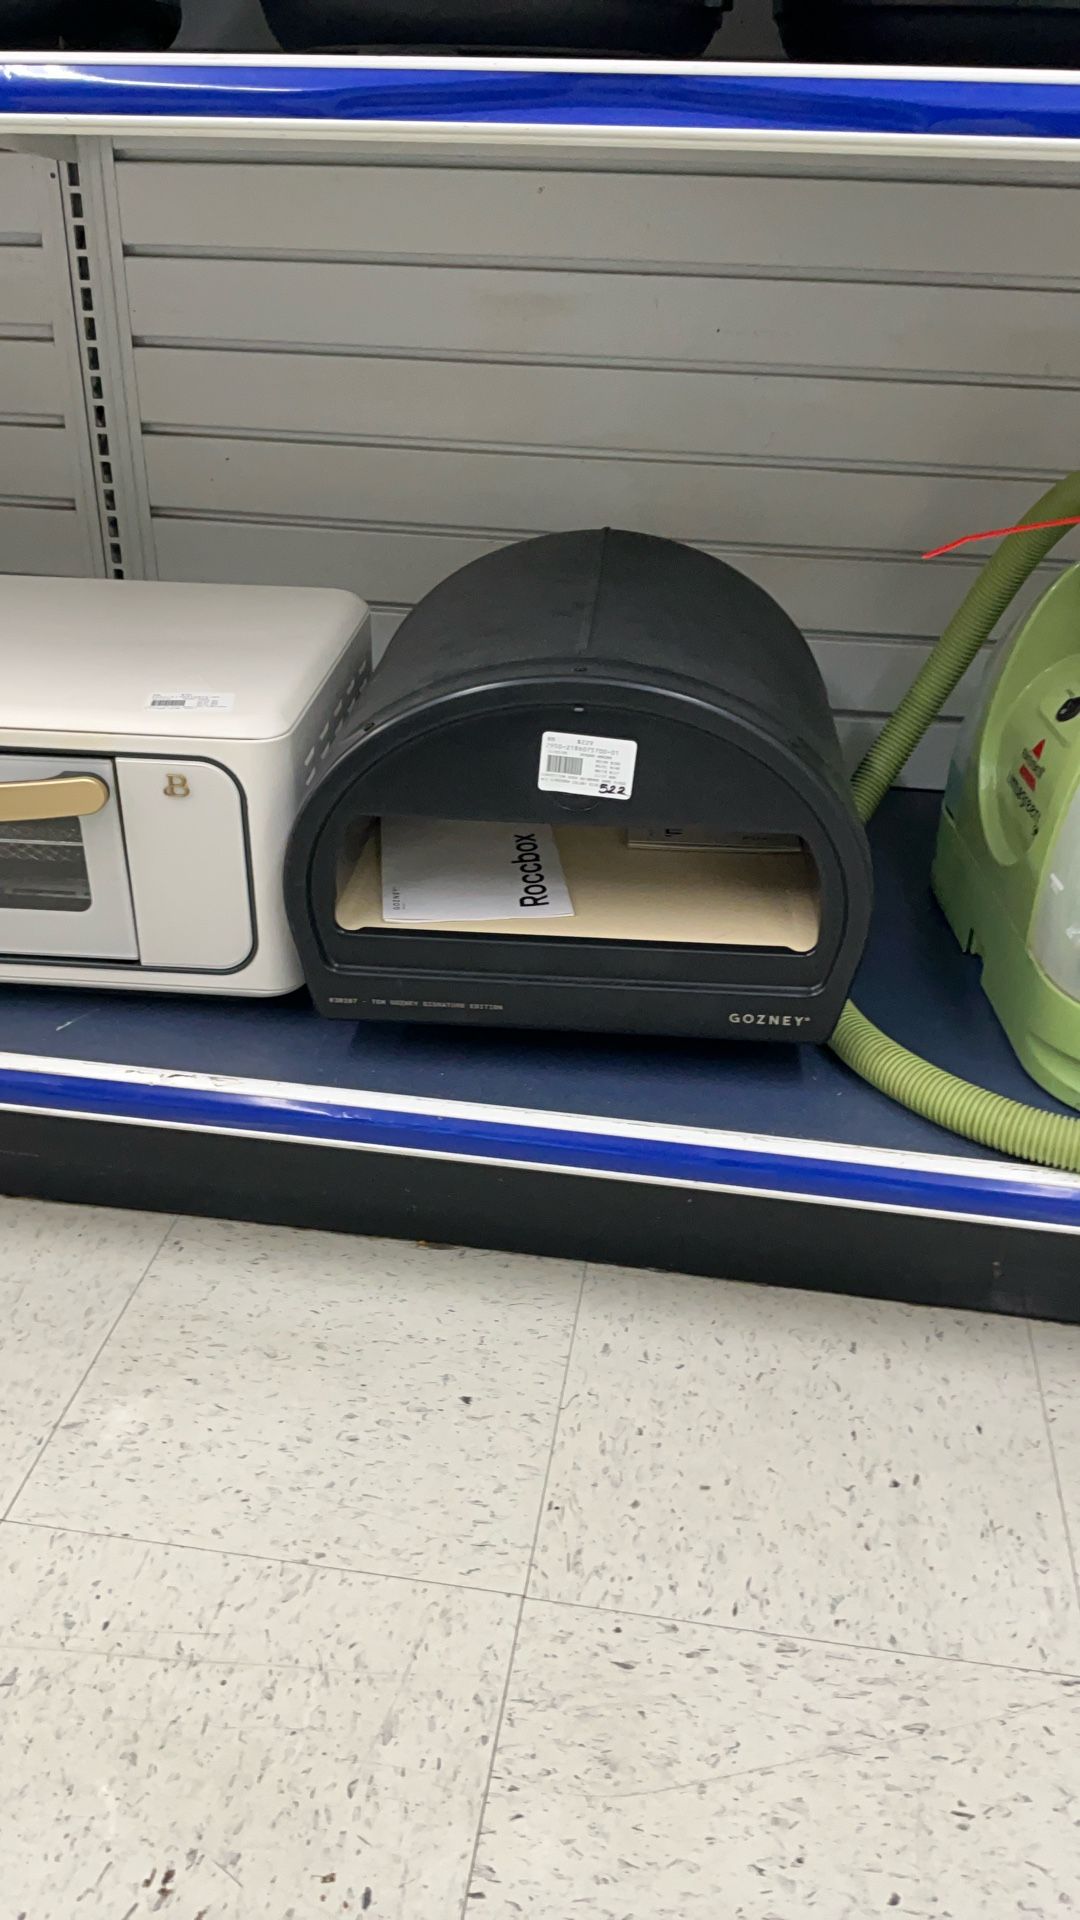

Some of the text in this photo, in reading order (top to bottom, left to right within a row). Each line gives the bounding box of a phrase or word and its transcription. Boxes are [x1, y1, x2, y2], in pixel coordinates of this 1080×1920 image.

[163, 774, 190, 797] B
[598, 783, 628, 796] 522
[511, 833, 549, 908] Roccbox
